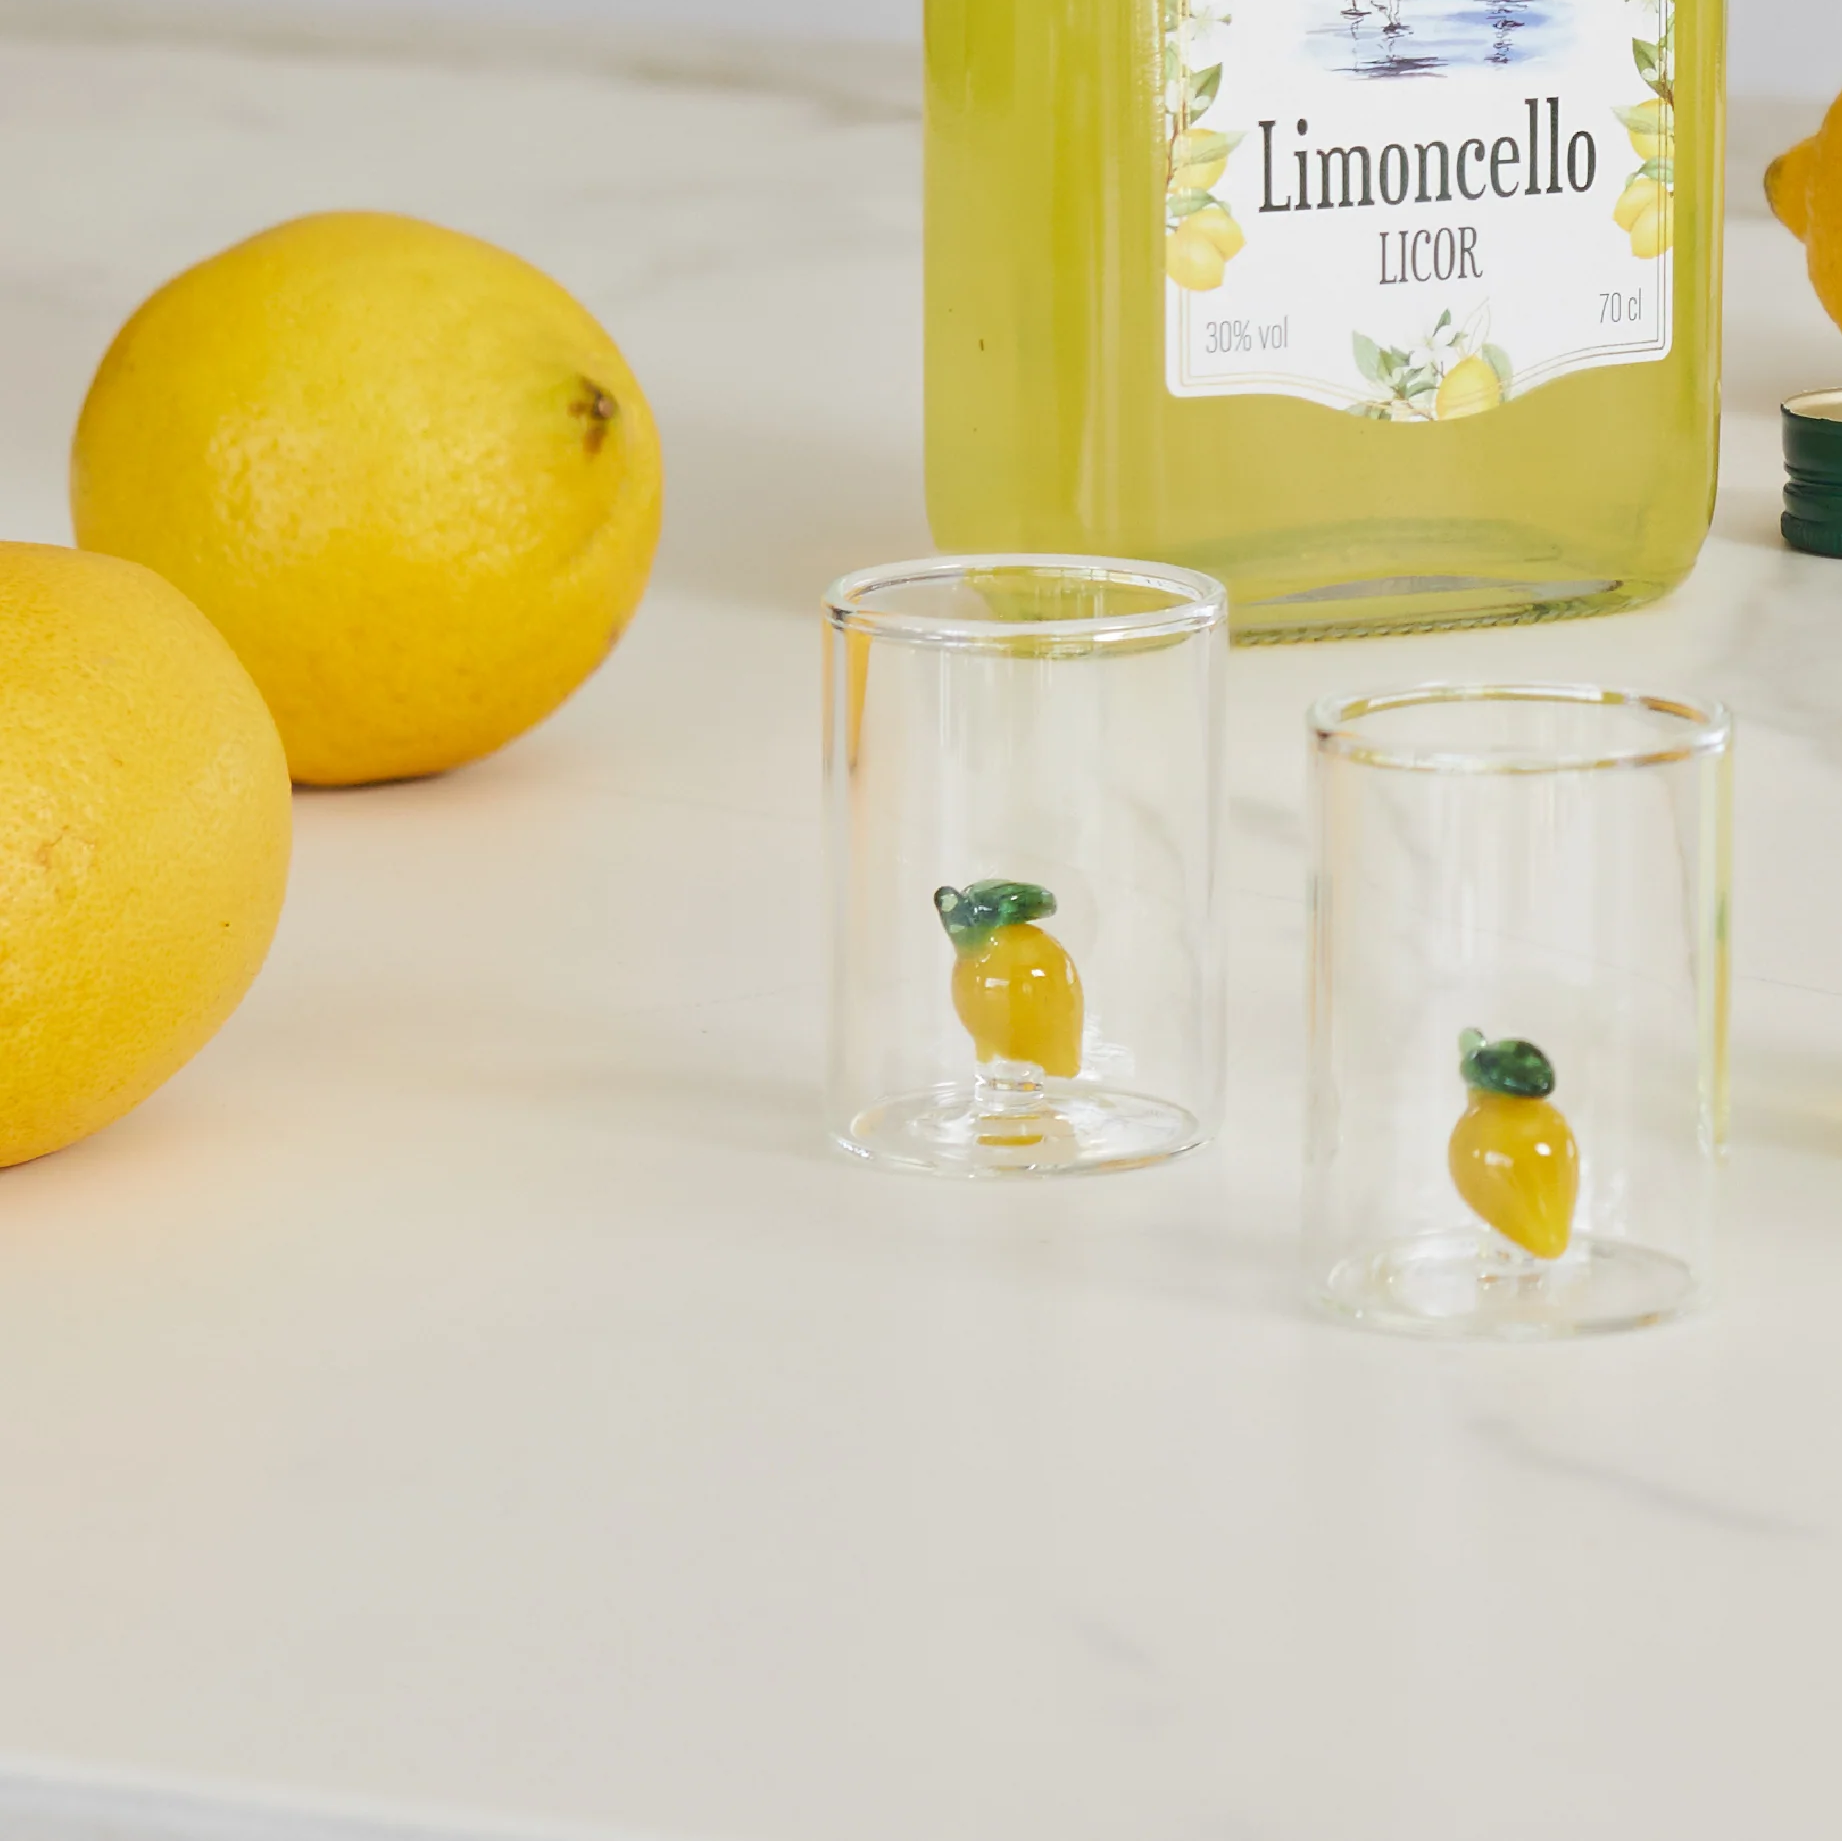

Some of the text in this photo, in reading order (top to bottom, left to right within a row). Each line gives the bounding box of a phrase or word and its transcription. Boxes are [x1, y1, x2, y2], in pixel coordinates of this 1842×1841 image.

[1257, 96, 1598, 213] Limoncello
[1378, 226, 1483, 285] LICOR
[1599, 288, 1642, 323] 70 cl
[1205, 315, 1289, 354] 30% vol
